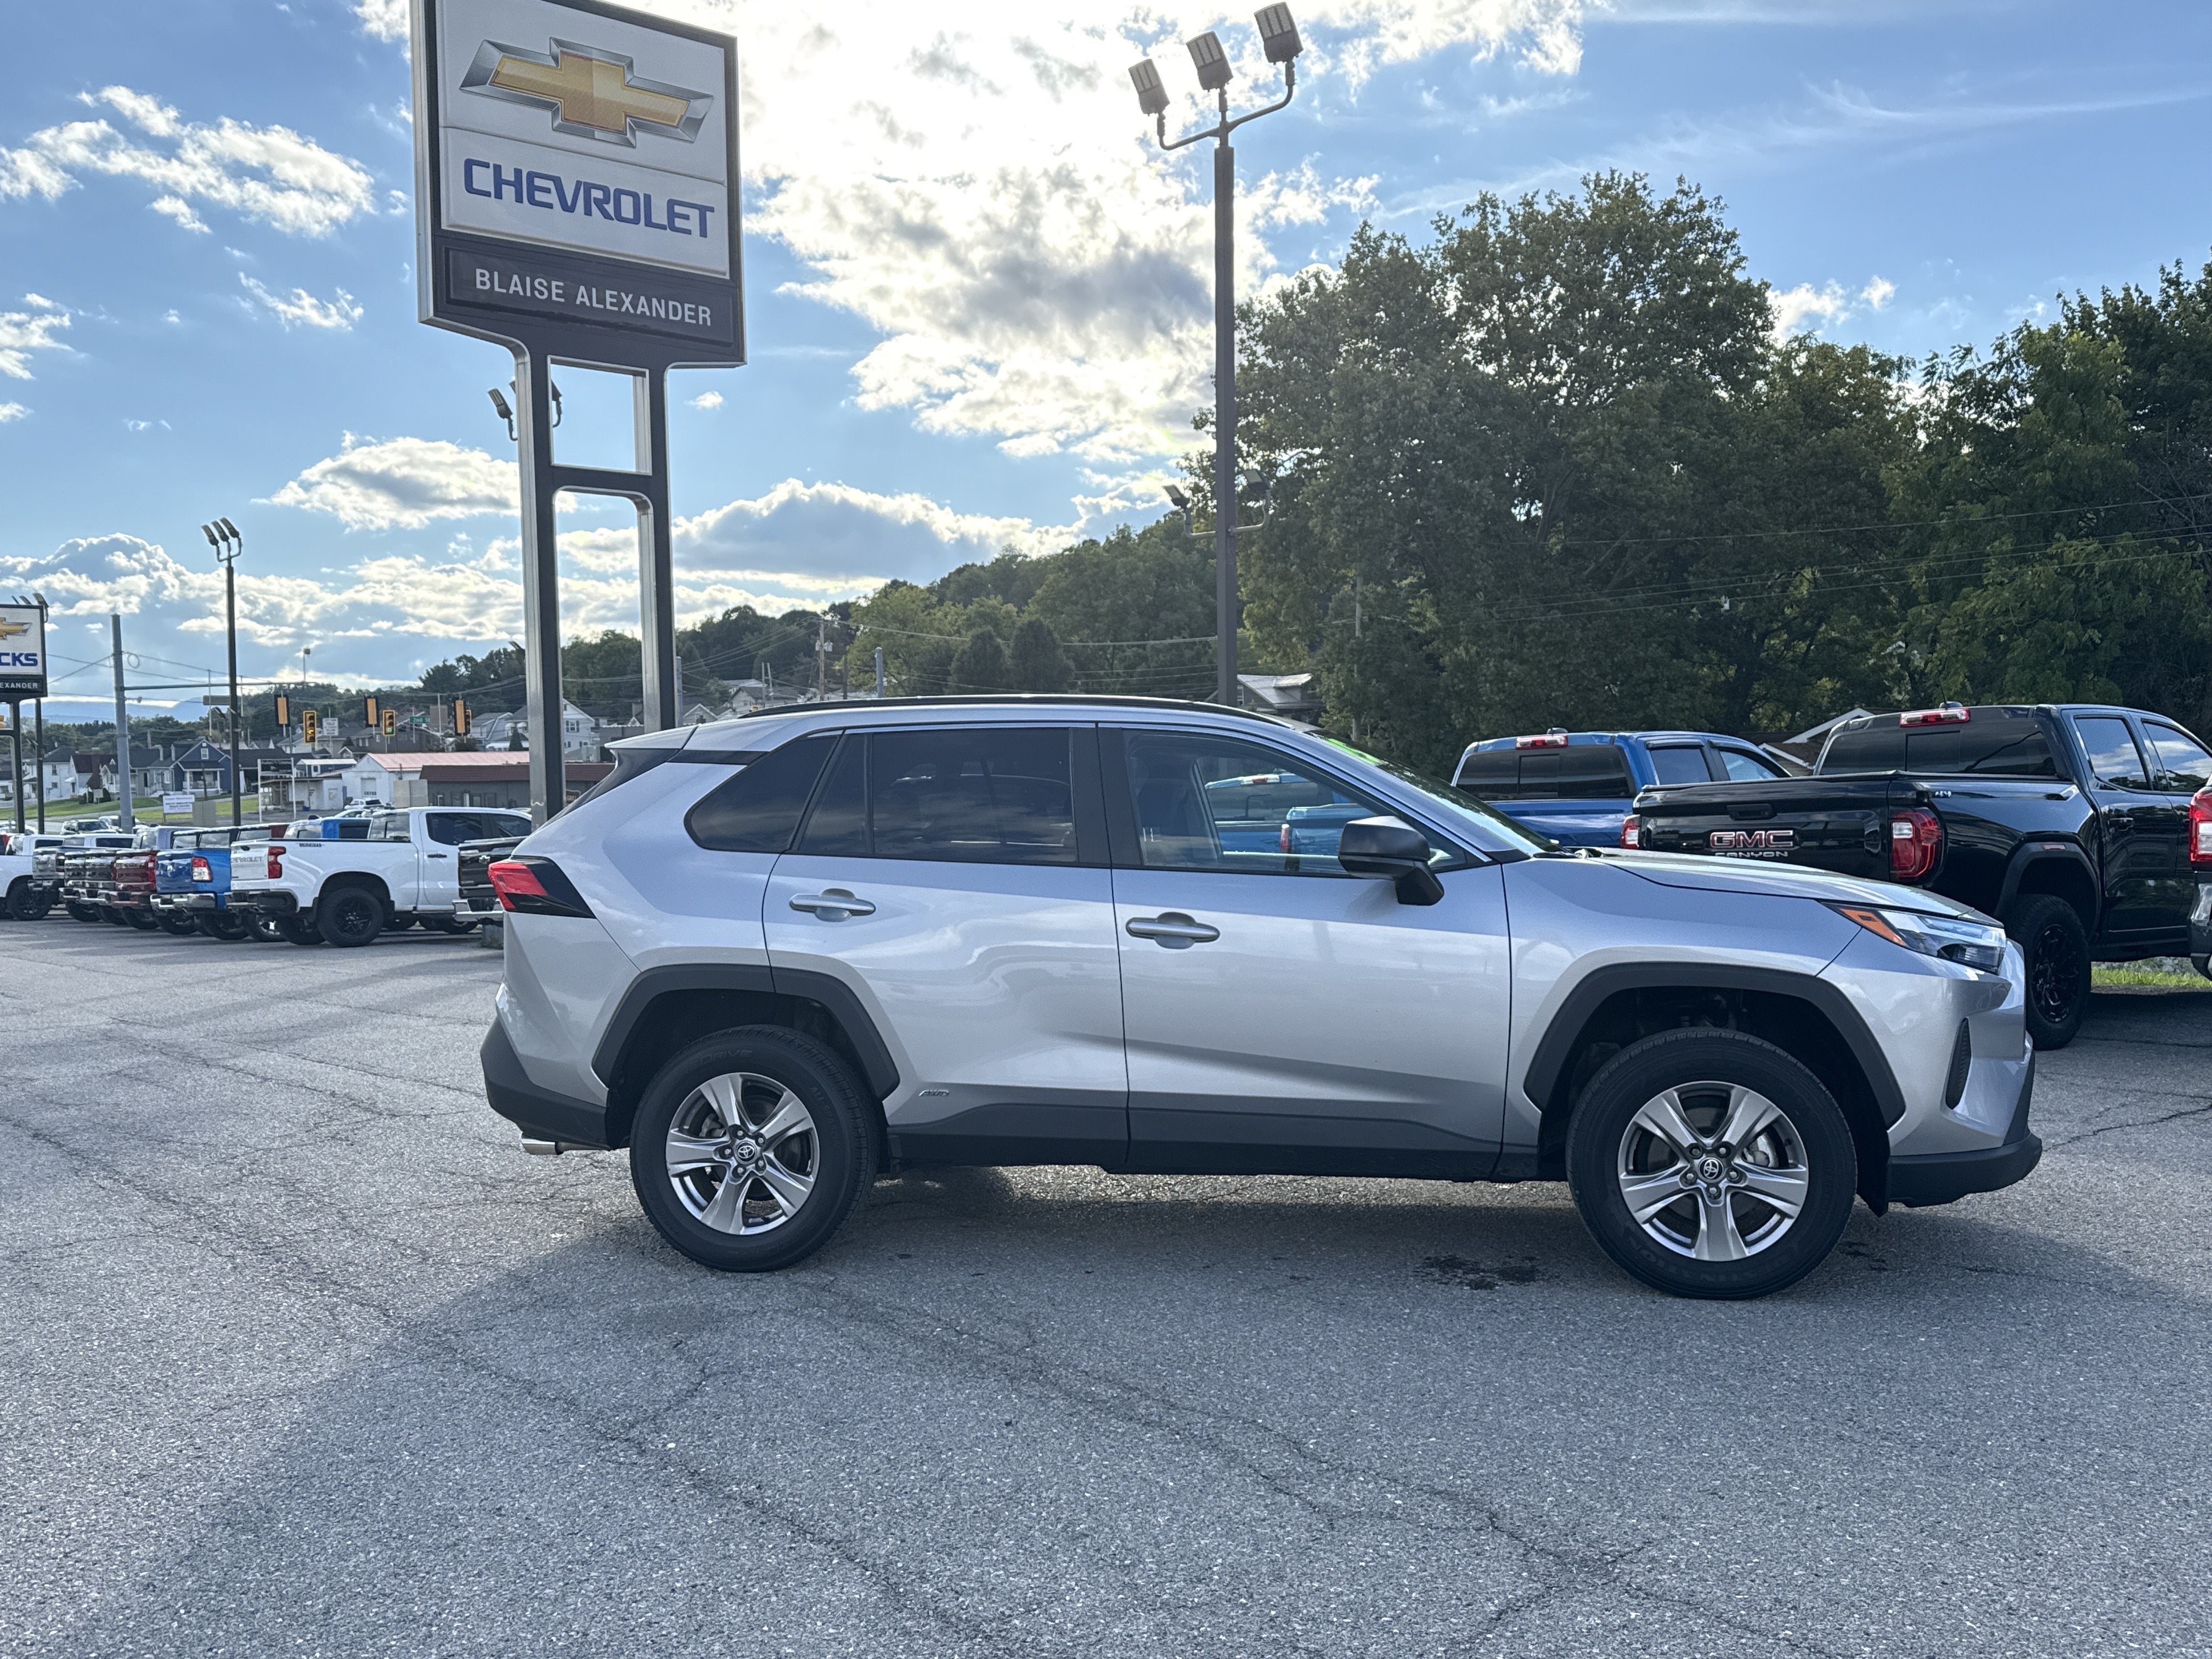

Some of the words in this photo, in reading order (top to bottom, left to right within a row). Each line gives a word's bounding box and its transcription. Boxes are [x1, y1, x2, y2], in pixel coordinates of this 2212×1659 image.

[464, 157, 715, 238] CHEVROLET
[475, 268, 566, 302] BLAISE
[575, 285, 712, 326] ALEXANDER
[1710, 830, 1793, 848] GMC
